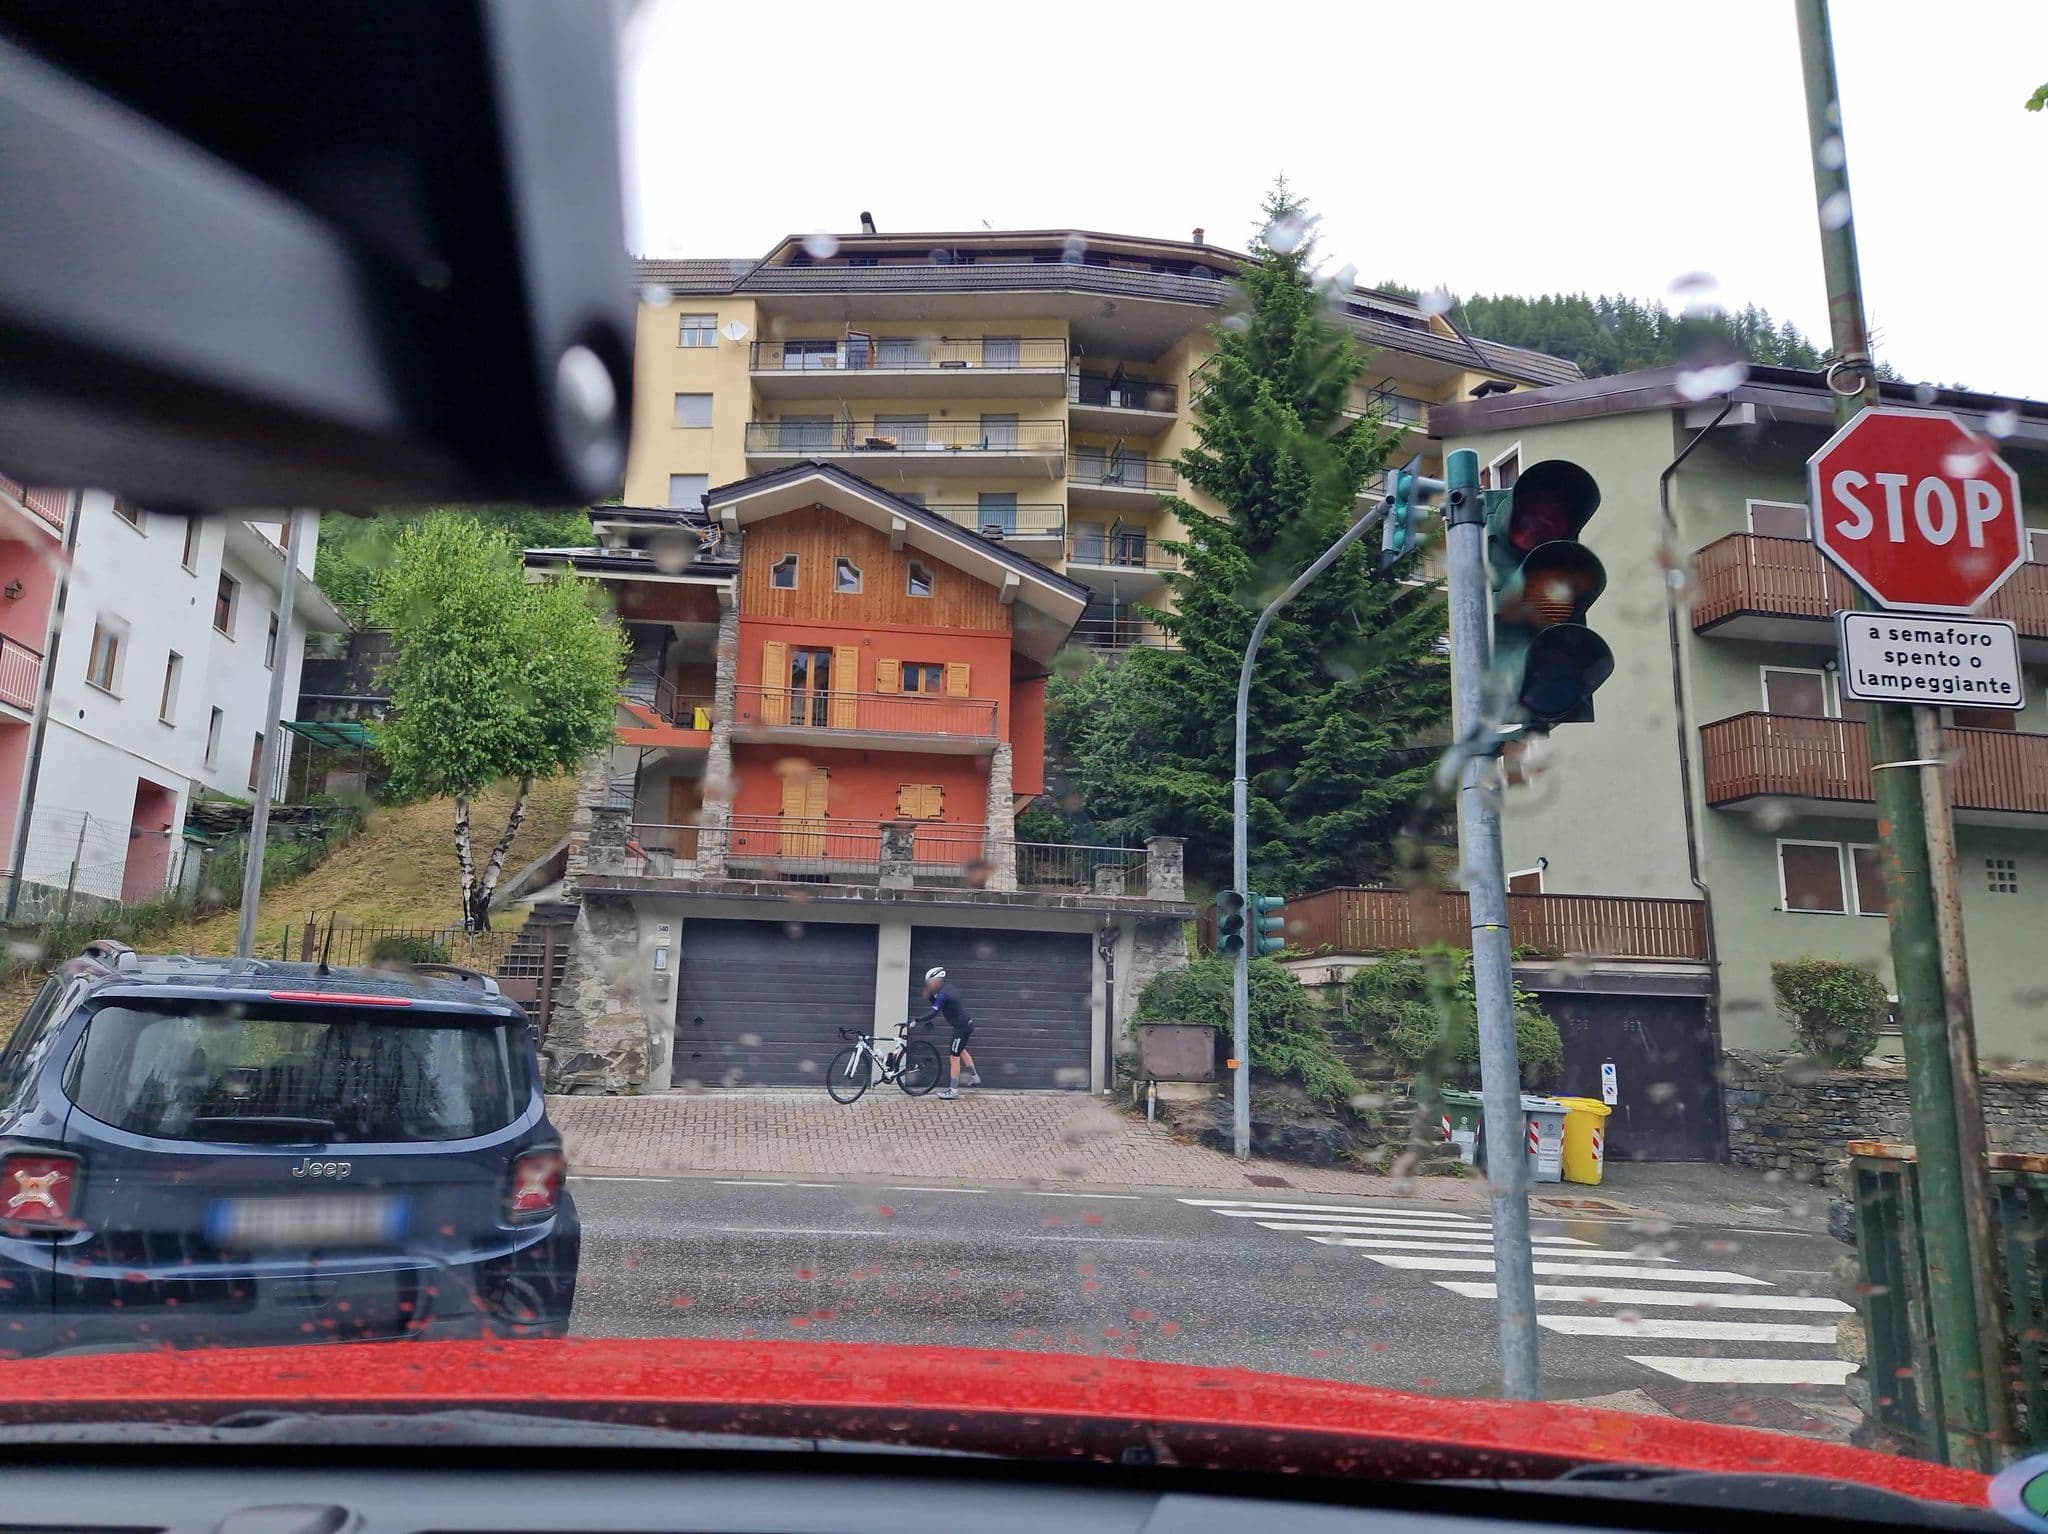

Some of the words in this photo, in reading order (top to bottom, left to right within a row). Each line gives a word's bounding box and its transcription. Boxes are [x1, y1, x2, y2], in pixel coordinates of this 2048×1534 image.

[1832, 470, 2002, 548] STOP
[1869, 627, 1880, 639] a
[1889, 628, 1992, 646] semaforo
[1884, 651, 1960, 667] spento
[1970, 656, 1982, 668] o
[1859, 669, 2012, 694] lampeggiante
[292, 1157, 352, 1181] Jeep
